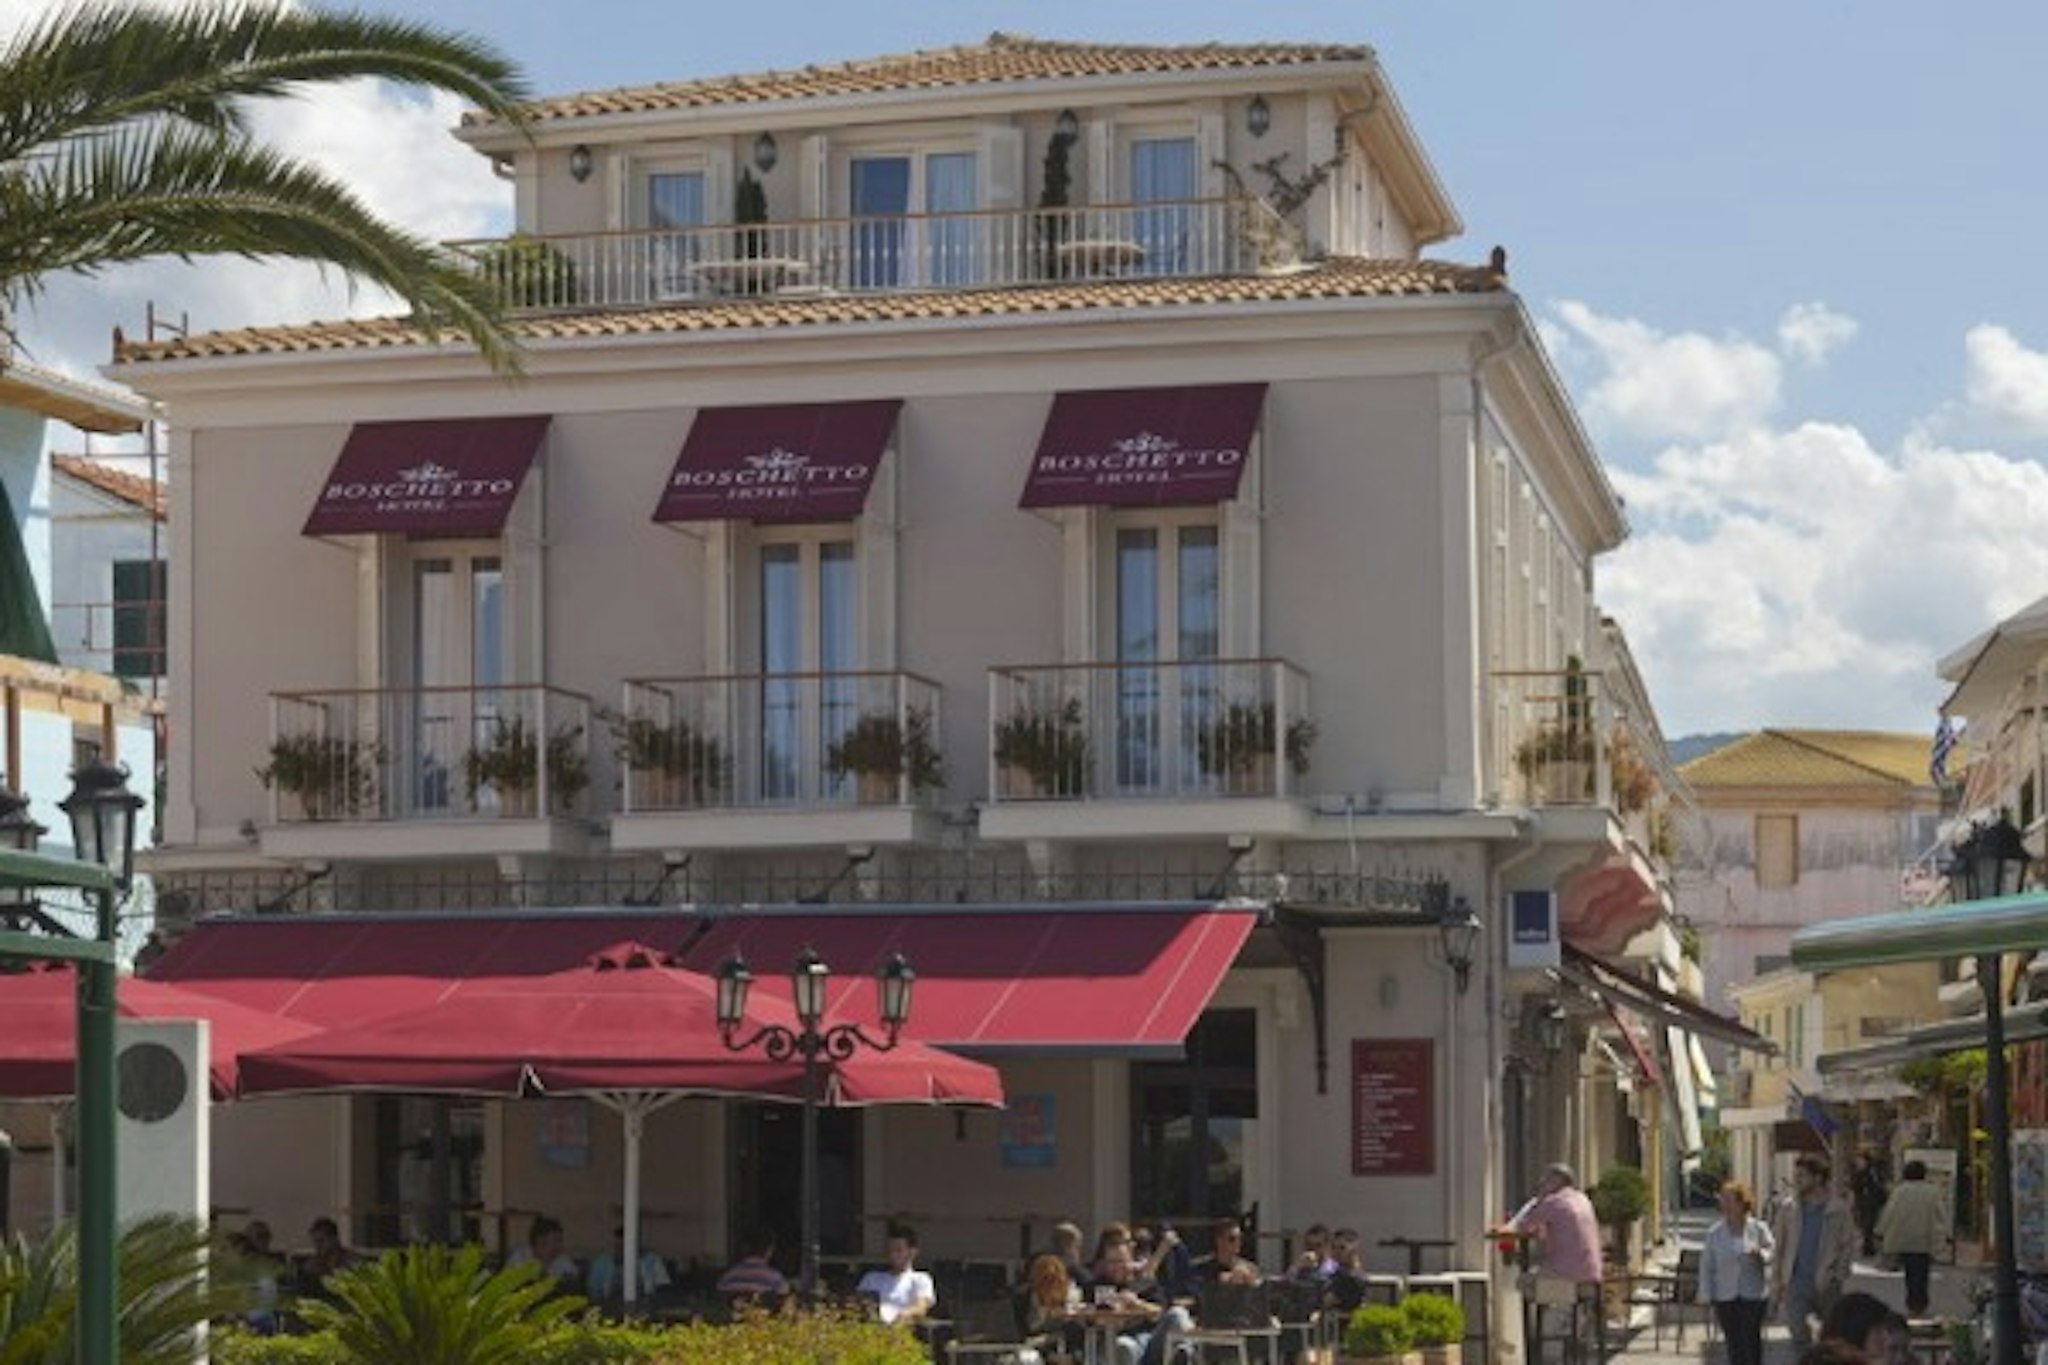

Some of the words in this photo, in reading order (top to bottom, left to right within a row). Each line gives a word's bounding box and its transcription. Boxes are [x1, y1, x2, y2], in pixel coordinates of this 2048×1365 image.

[1040, 449, 1240, 472] BOSCHETTO
[674, 464, 869, 486] BOSCHETTO
[326, 479, 514, 500] BOSCHETTO
